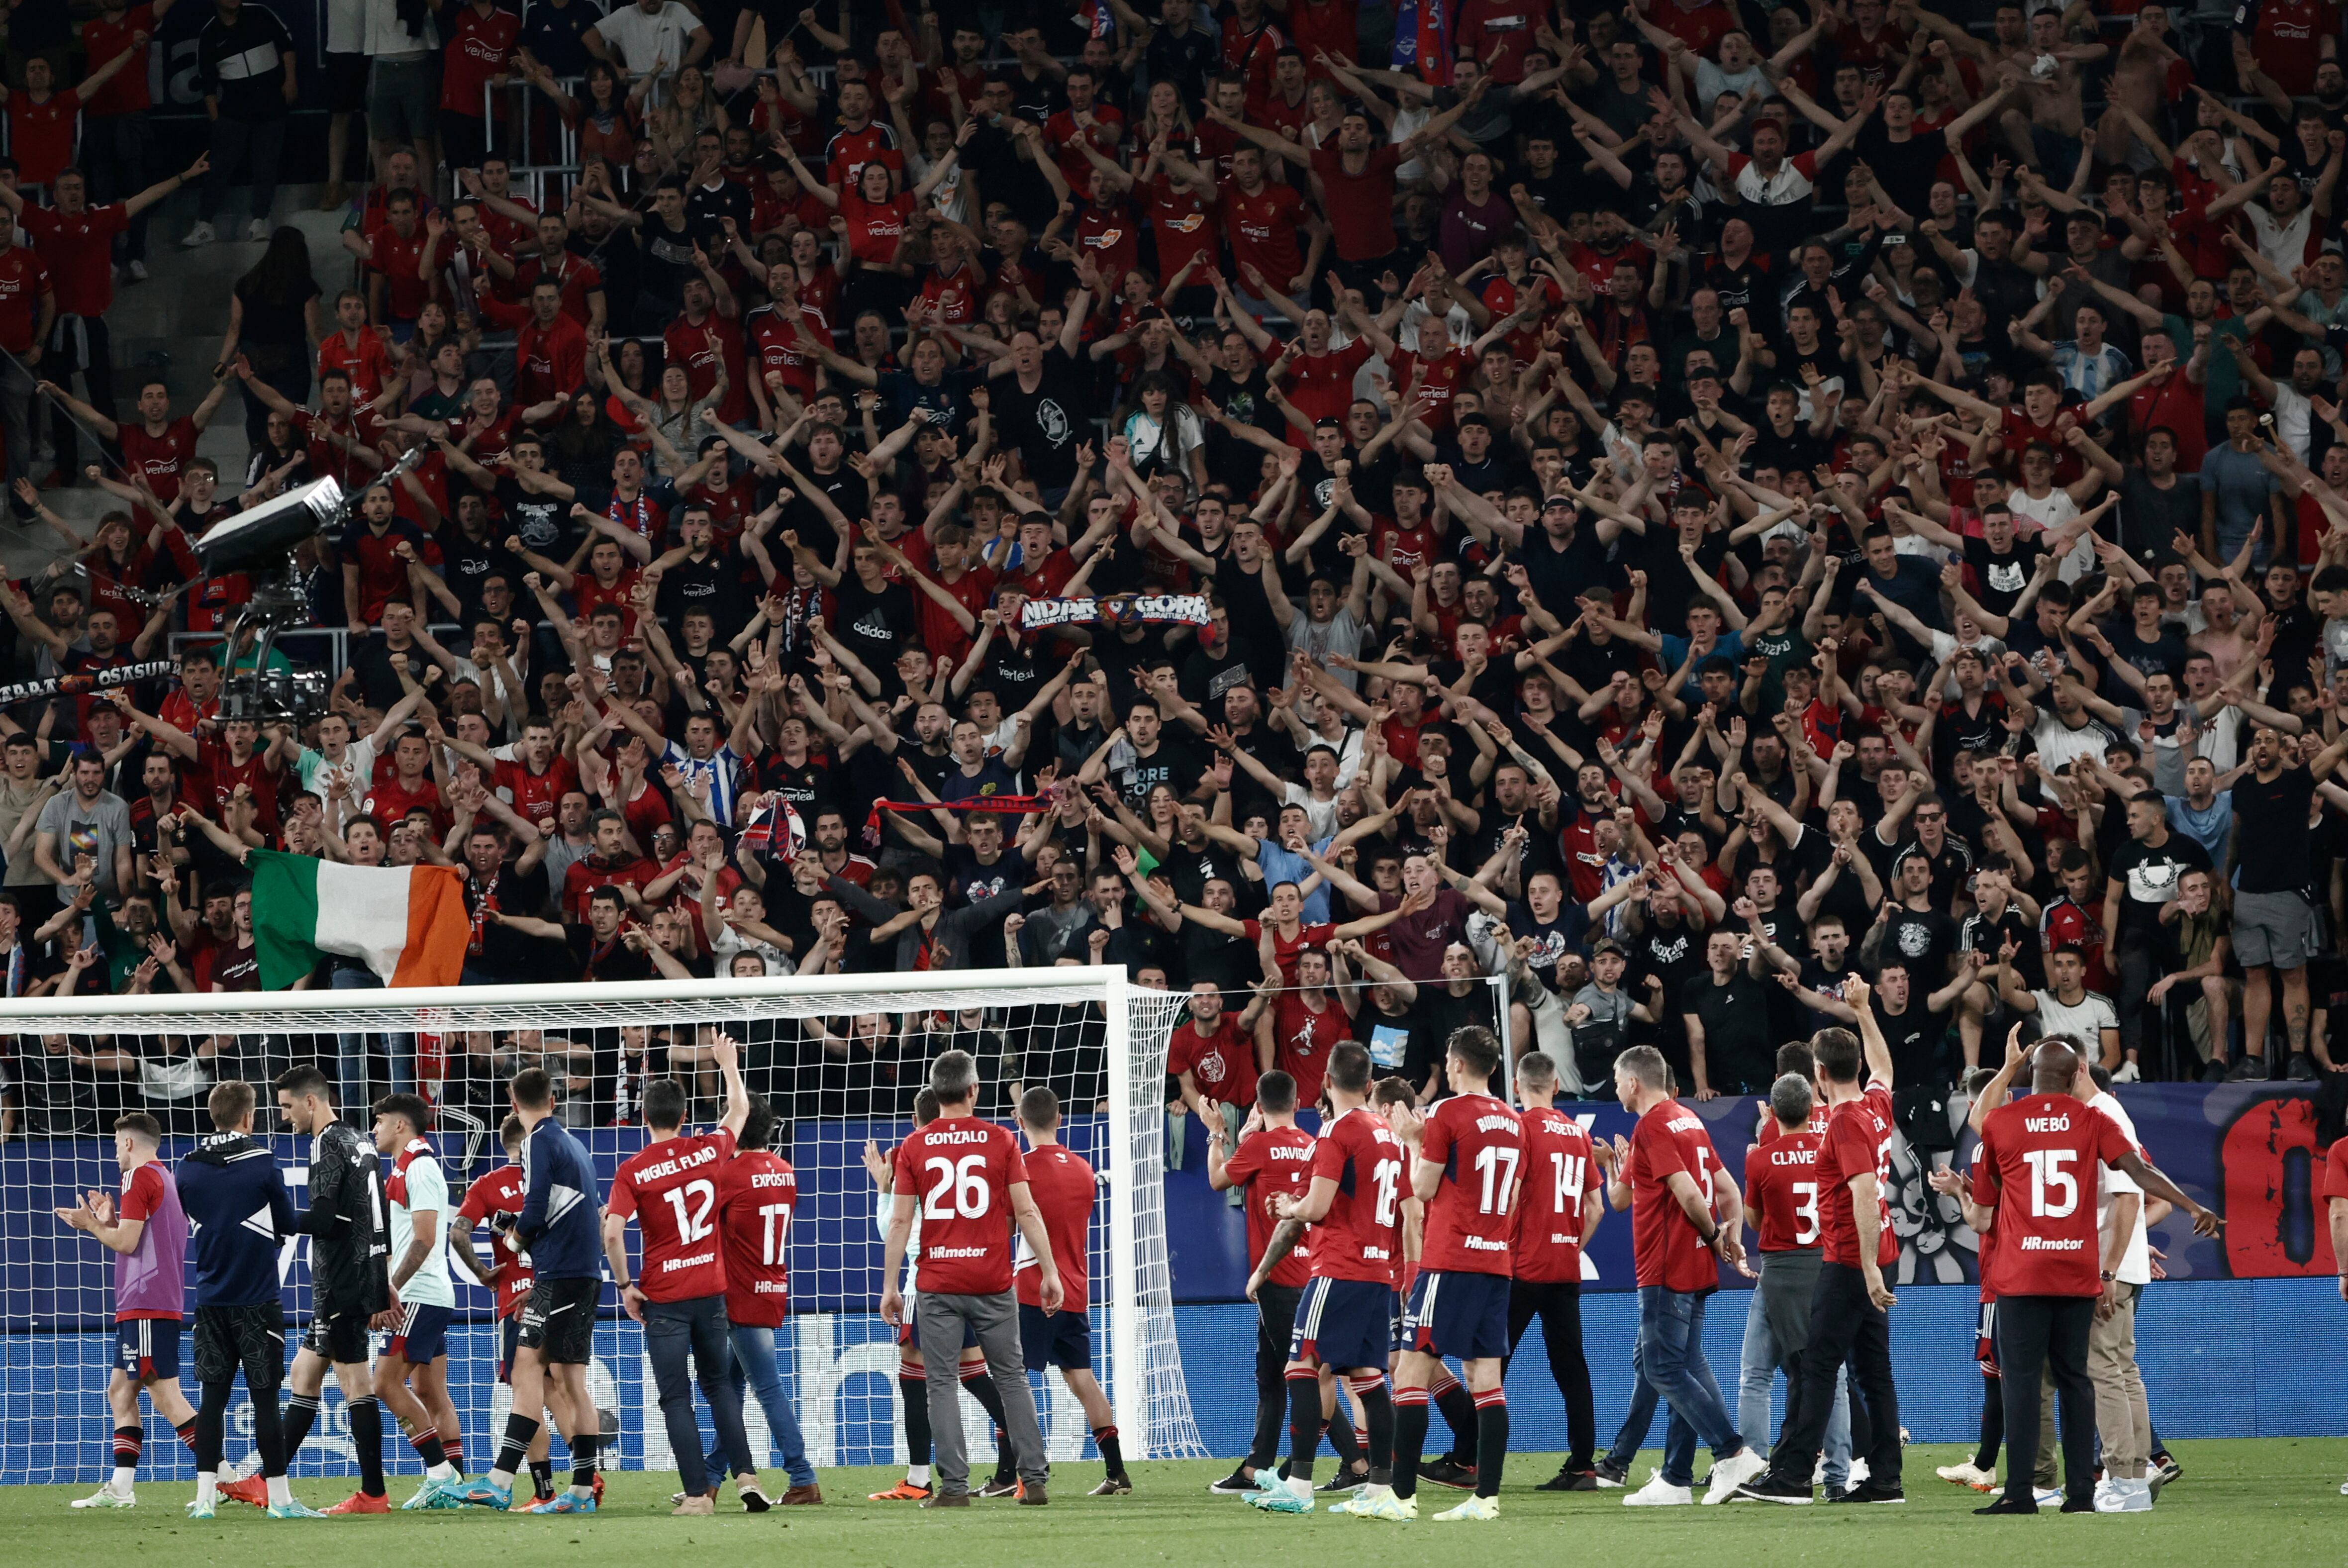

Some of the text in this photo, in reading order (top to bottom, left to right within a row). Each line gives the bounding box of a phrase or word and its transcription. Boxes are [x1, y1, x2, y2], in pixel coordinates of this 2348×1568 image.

[2273, 29, 2310, 39] verleal
[867, 224, 900, 237] verleal
[1418, 390, 1450, 398] verleal
[145, 461, 178, 475] verleal
[853, 622, 893, 640] adidas
[998, 667, 1035, 682] verleal
[1475, 1114, 1519, 1138] BUDIMIR
[2025, 1112, 2070, 1133] WEBÓ
[924, 1130, 988, 1146] GONZALO
[634, 1160, 681, 1185] MIGUEL
[751, 1169, 796, 1188] EXPÓSITO
[1474, 1146, 1521, 1215] 17
[924, 1155, 990, 1220] 26
[1550, 1152, 1586, 1218] 14
[2023, 1150, 2077, 1218] 15
[368, 1170, 385, 1233] 1
[663, 1178, 714, 1246] 12
[1792, 1182, 1821, 1246] 3
[759, 1203, 790, 1266] 17
[2021, 1237, 2084, 1250] HRmotor
[662, 1252, 715, 1274] HRmotor
[929, 1246, 987, 1259] HRmotor
